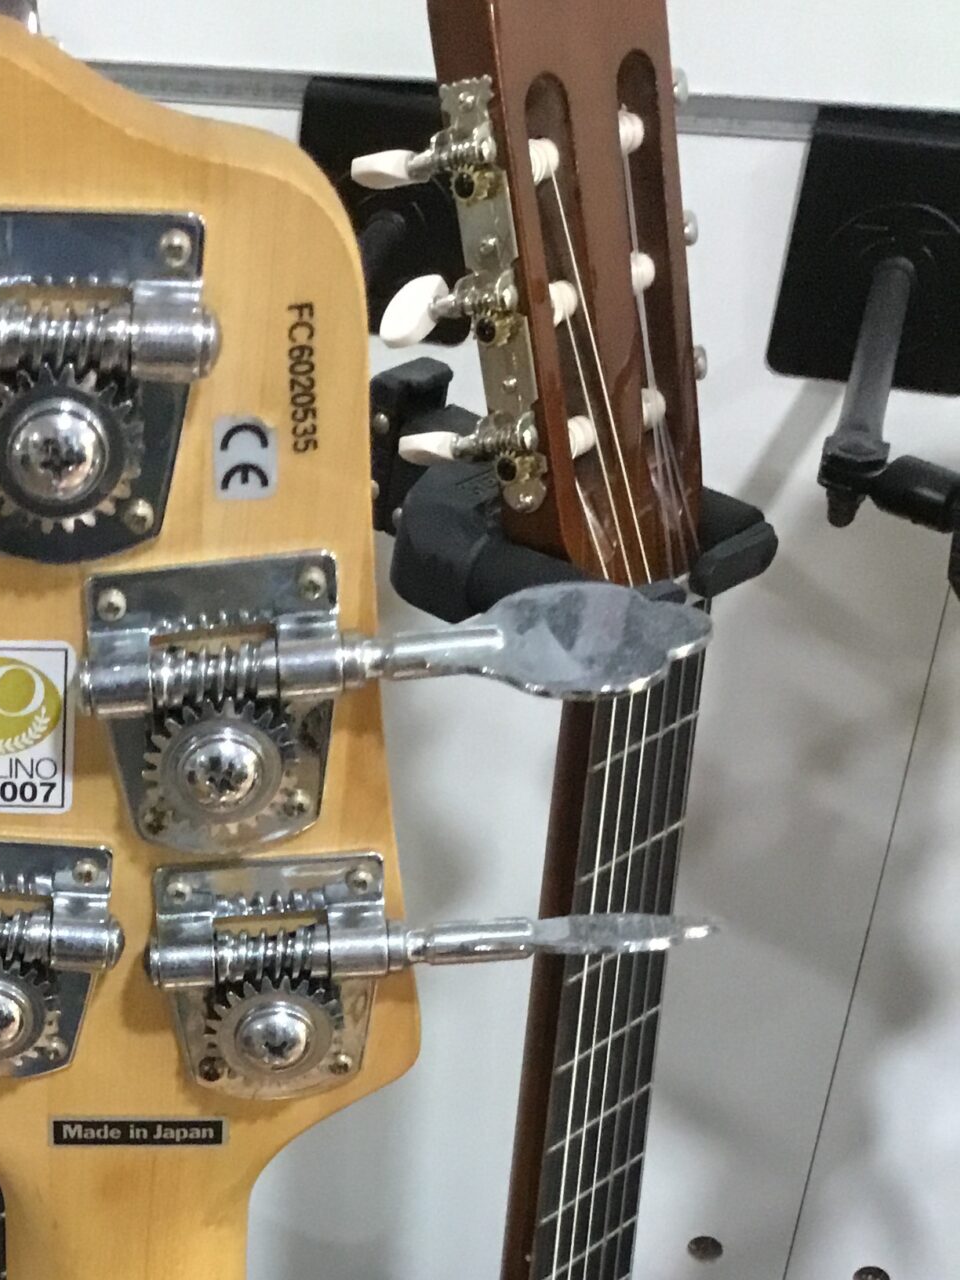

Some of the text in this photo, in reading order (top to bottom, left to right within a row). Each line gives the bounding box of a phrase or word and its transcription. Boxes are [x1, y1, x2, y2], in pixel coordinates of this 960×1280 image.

[288, 301, 318, 454] FC6020535
[62, 1124, 215, 1142] Made in Japan
